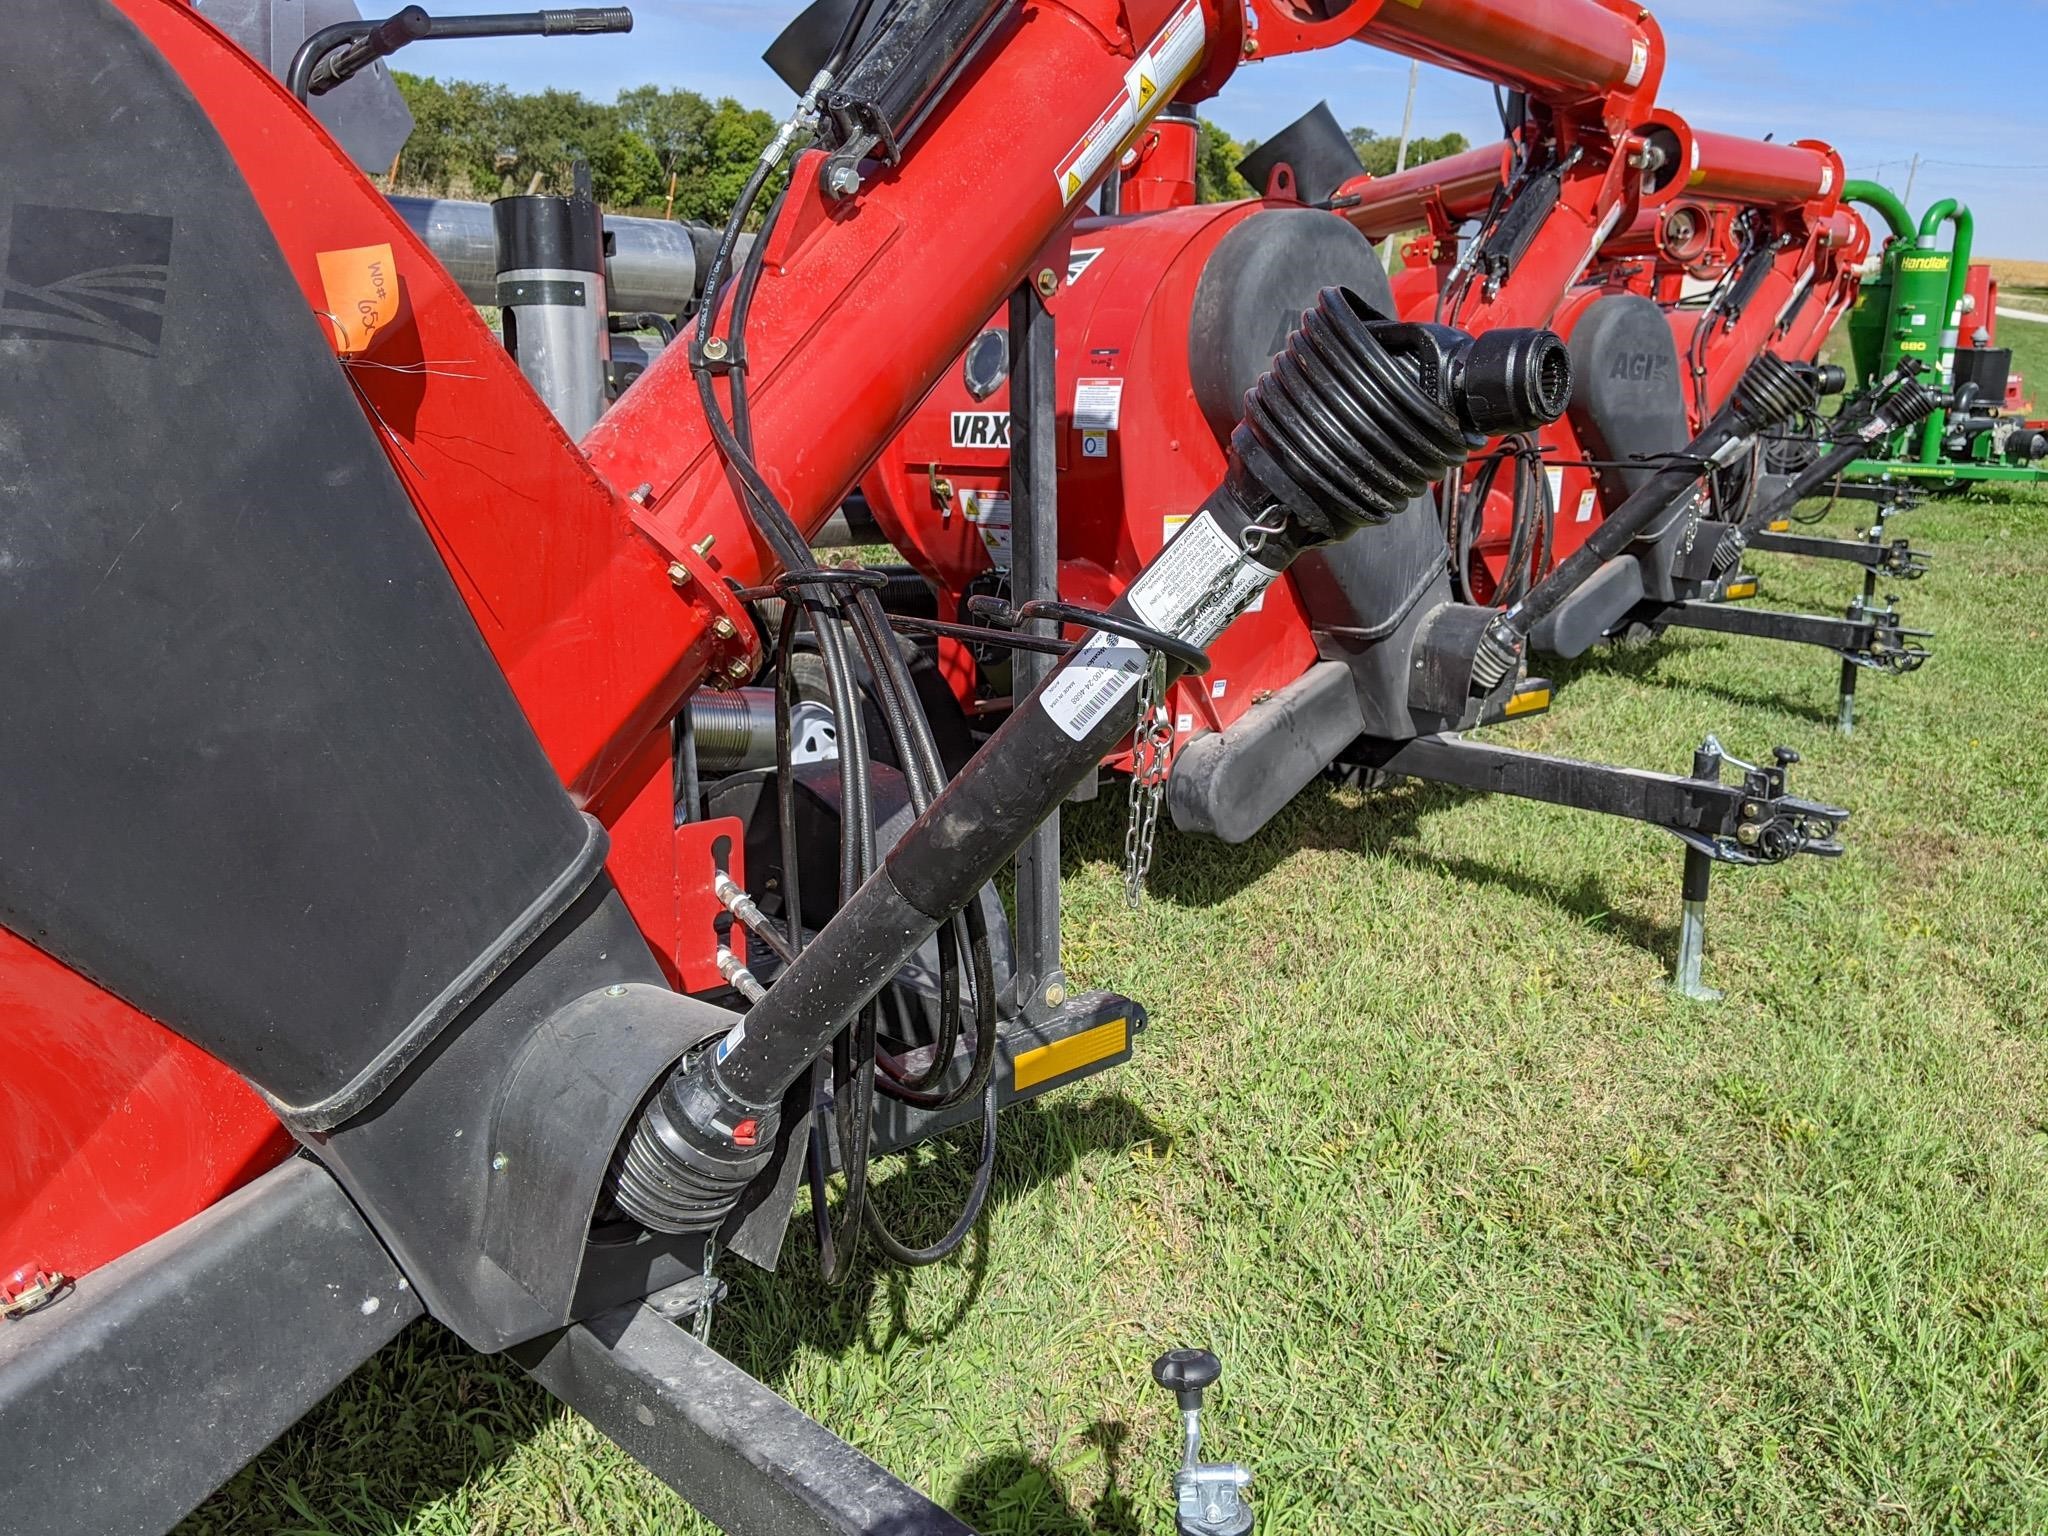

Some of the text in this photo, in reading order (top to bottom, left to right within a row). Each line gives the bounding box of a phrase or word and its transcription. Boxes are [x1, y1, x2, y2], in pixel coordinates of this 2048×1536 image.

[1609, 352, 1653, 381] AGI
[953, 416, 1010, 444] VRX
[1193, 521, 1203, 532] DO
[1181, 530, 1195, 544] NOT
[1191, 533, 1209, 552] FREELY
[1198, 537, 1213, 553] DRIVE
[1171, 542, 1183, 555] USE
[1193, 542, 1217, 568] ATTACHED
[1207, 547, 1222, 563] DRIVE
[1160, 554, 1173, 567] PTO
[1185, 550, 1201, 566] SHAFT
[1194, 560, 1210, 577] SHAFT
[1134, 565, 1162, 596] ADAPTORS
[1226, 573, 1258, 608] ROTATING
[1207, 605, 1227, 627] DRIVE
[1190, 625, 1209, 645] SHAF
